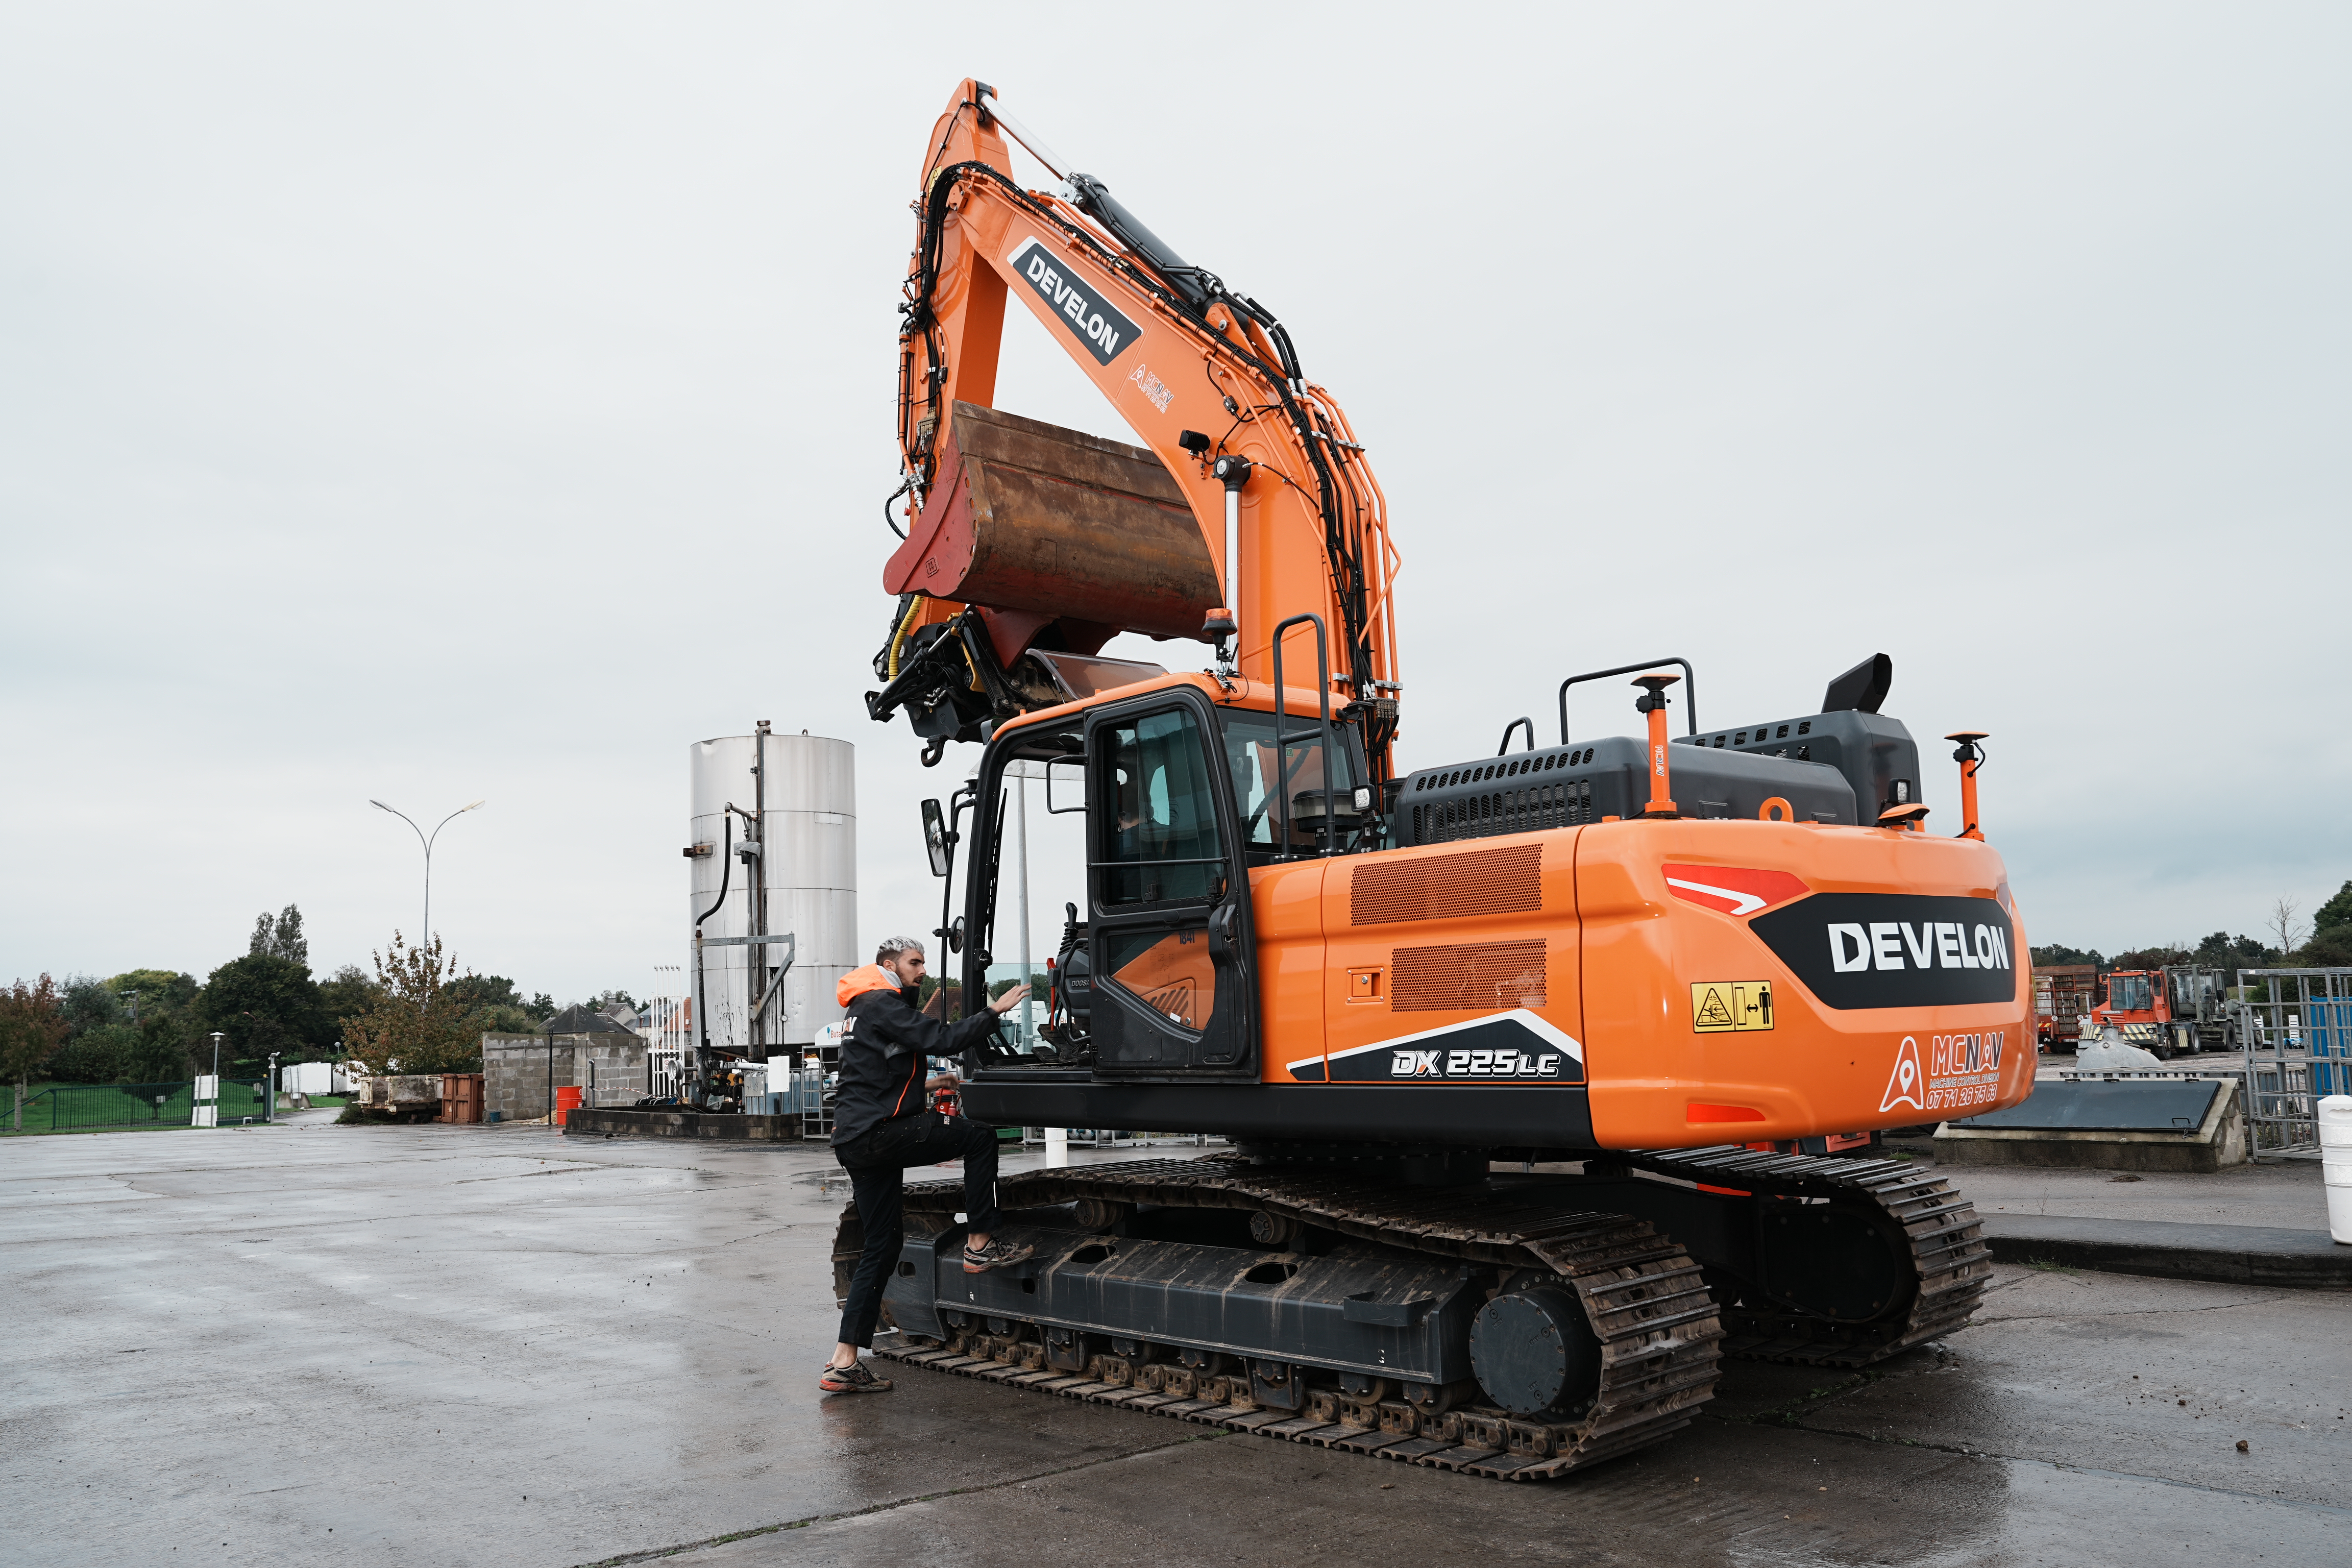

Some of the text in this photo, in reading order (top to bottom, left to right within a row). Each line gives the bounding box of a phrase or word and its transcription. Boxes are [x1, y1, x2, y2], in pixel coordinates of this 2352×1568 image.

[1027, 254, 1119, 356] DEVELON
[1141, 385, 1167, 414] 07 71 26 75 63
[1145, 371, 1174, 404] MCNAV
[1655, 745, 1664, 776] MCNAV
[1179, 930, 1195, 944] 1841
[1827, 922, 2010, 972] DEVELON
[1391, 1050, 1442, 1077] DX
[1931, 1031, 2004, 1076] MCNAV
[1929, 1072, 2000, 1089] MACHINE CONTROL DIVISION
[1926, 1083, 1997, 1110] 07 71 26 75 63
